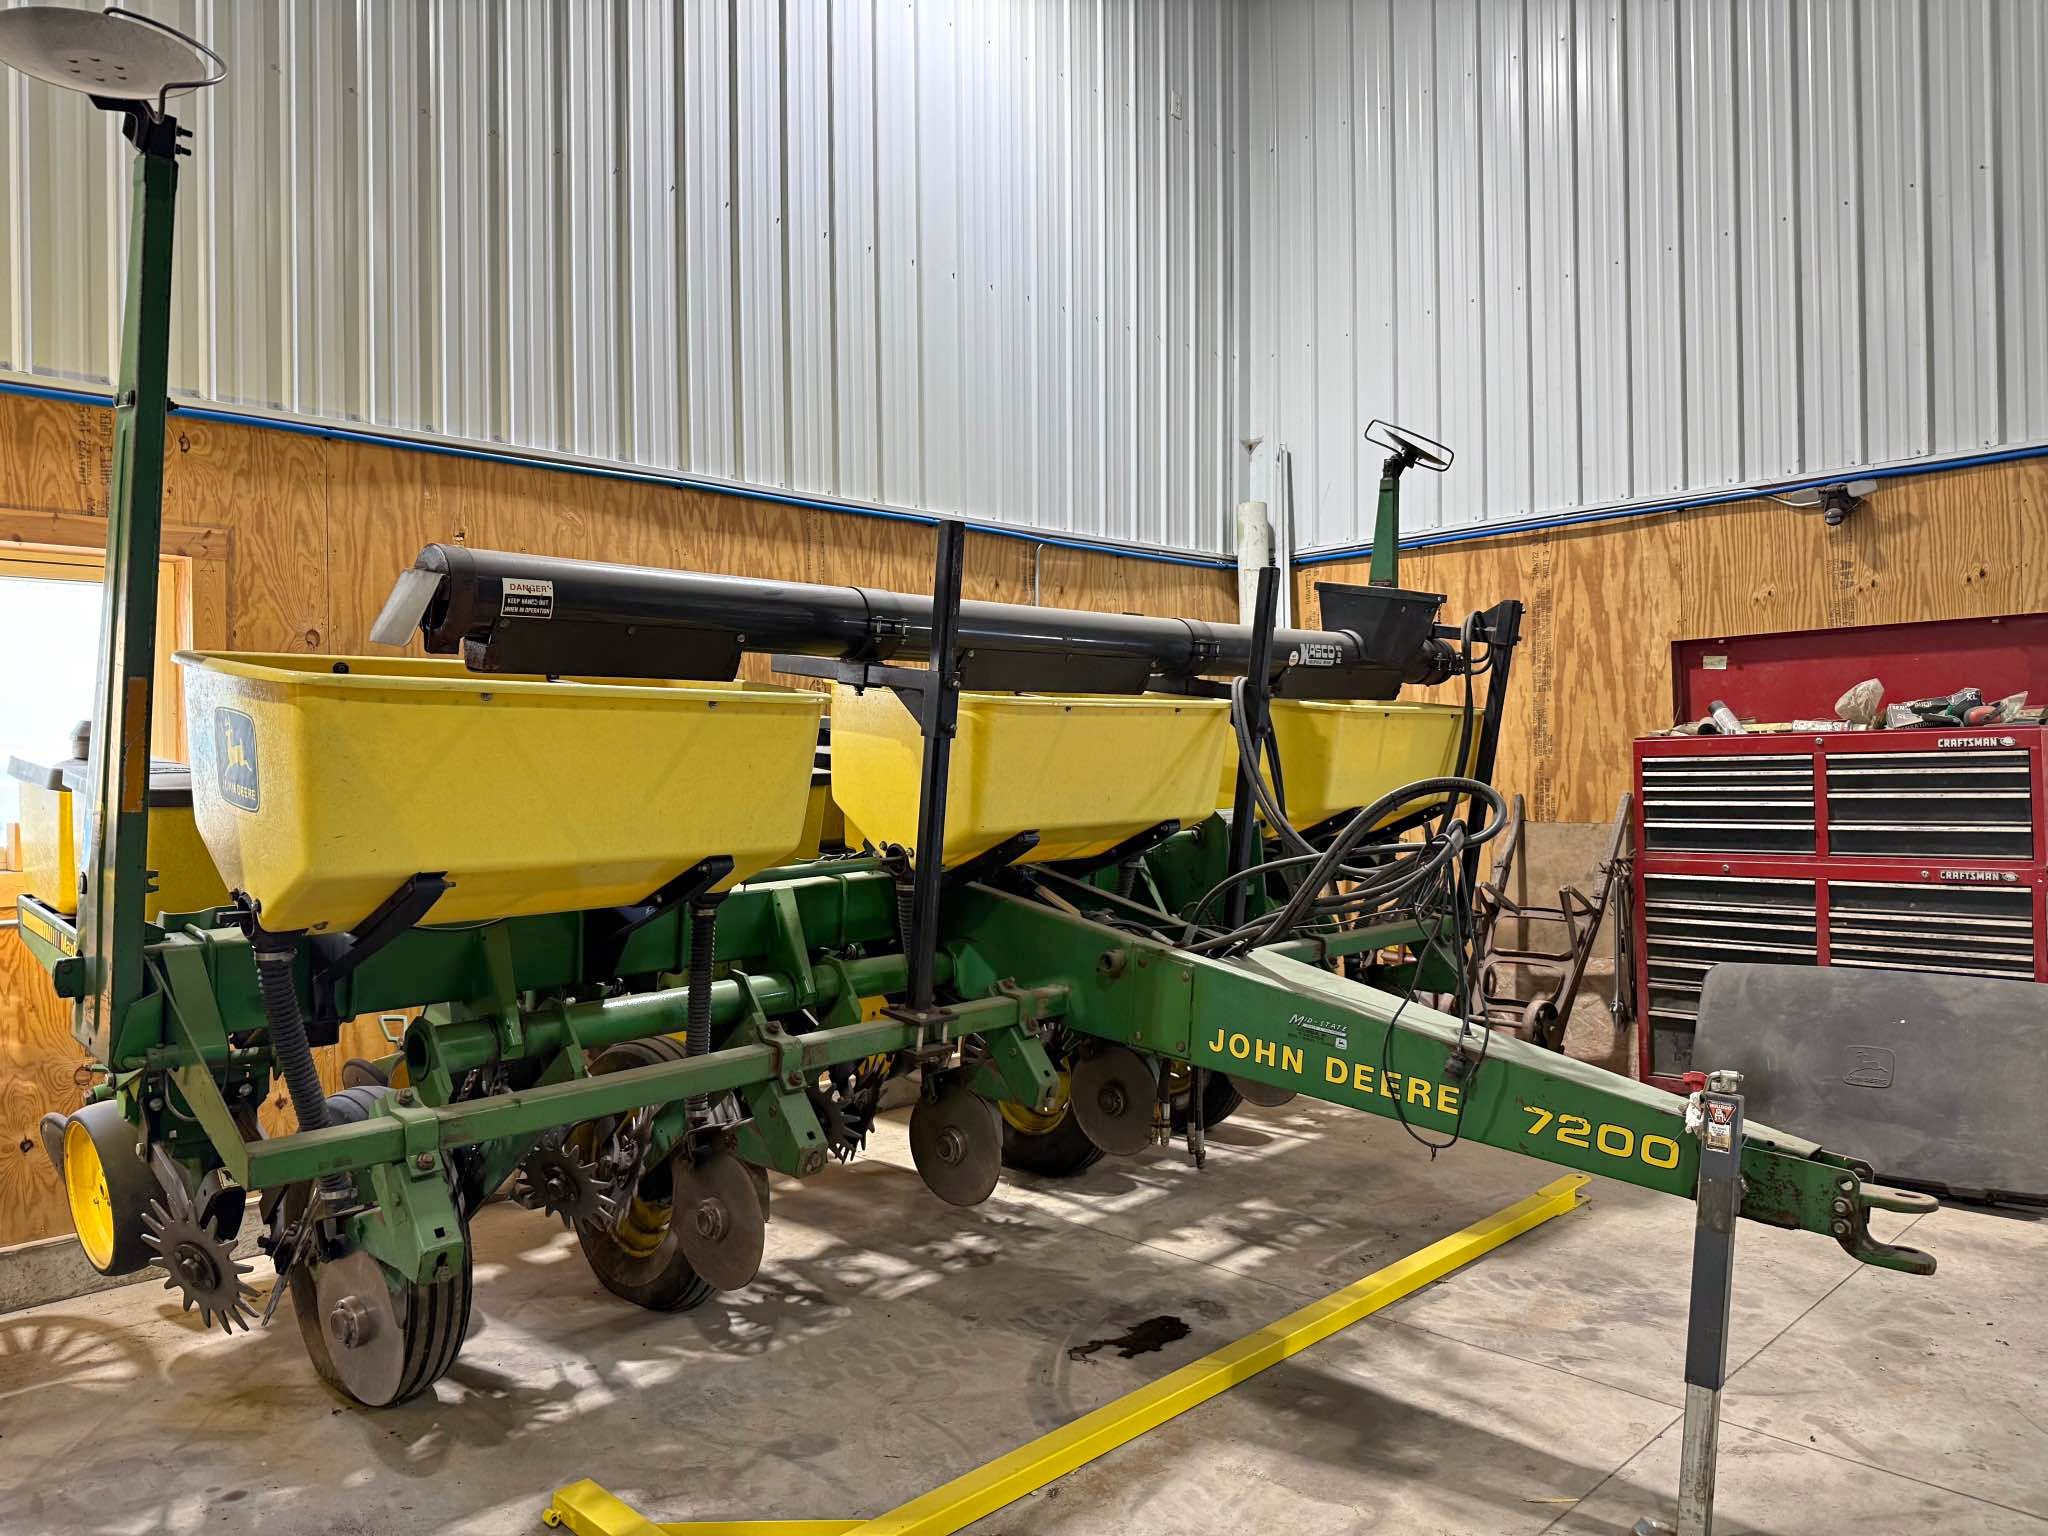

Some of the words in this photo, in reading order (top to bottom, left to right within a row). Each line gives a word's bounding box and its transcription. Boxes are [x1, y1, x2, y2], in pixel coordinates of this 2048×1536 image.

[509, 583, 547, 593] DANGER
[507, 597, 521, 605] KEEP
[525, 607, 550, 615] OPERATION
[1937, 737, 1998, 748] CRAFTSMAN
[1940, 870, 2000, 881] CRAFTSMAN
[1208, 1028, 1304, 1074] JOHN
[1325, 1056, 1462, 1116] DEERE
[1522, 1105, 1681, 1170] 7200
